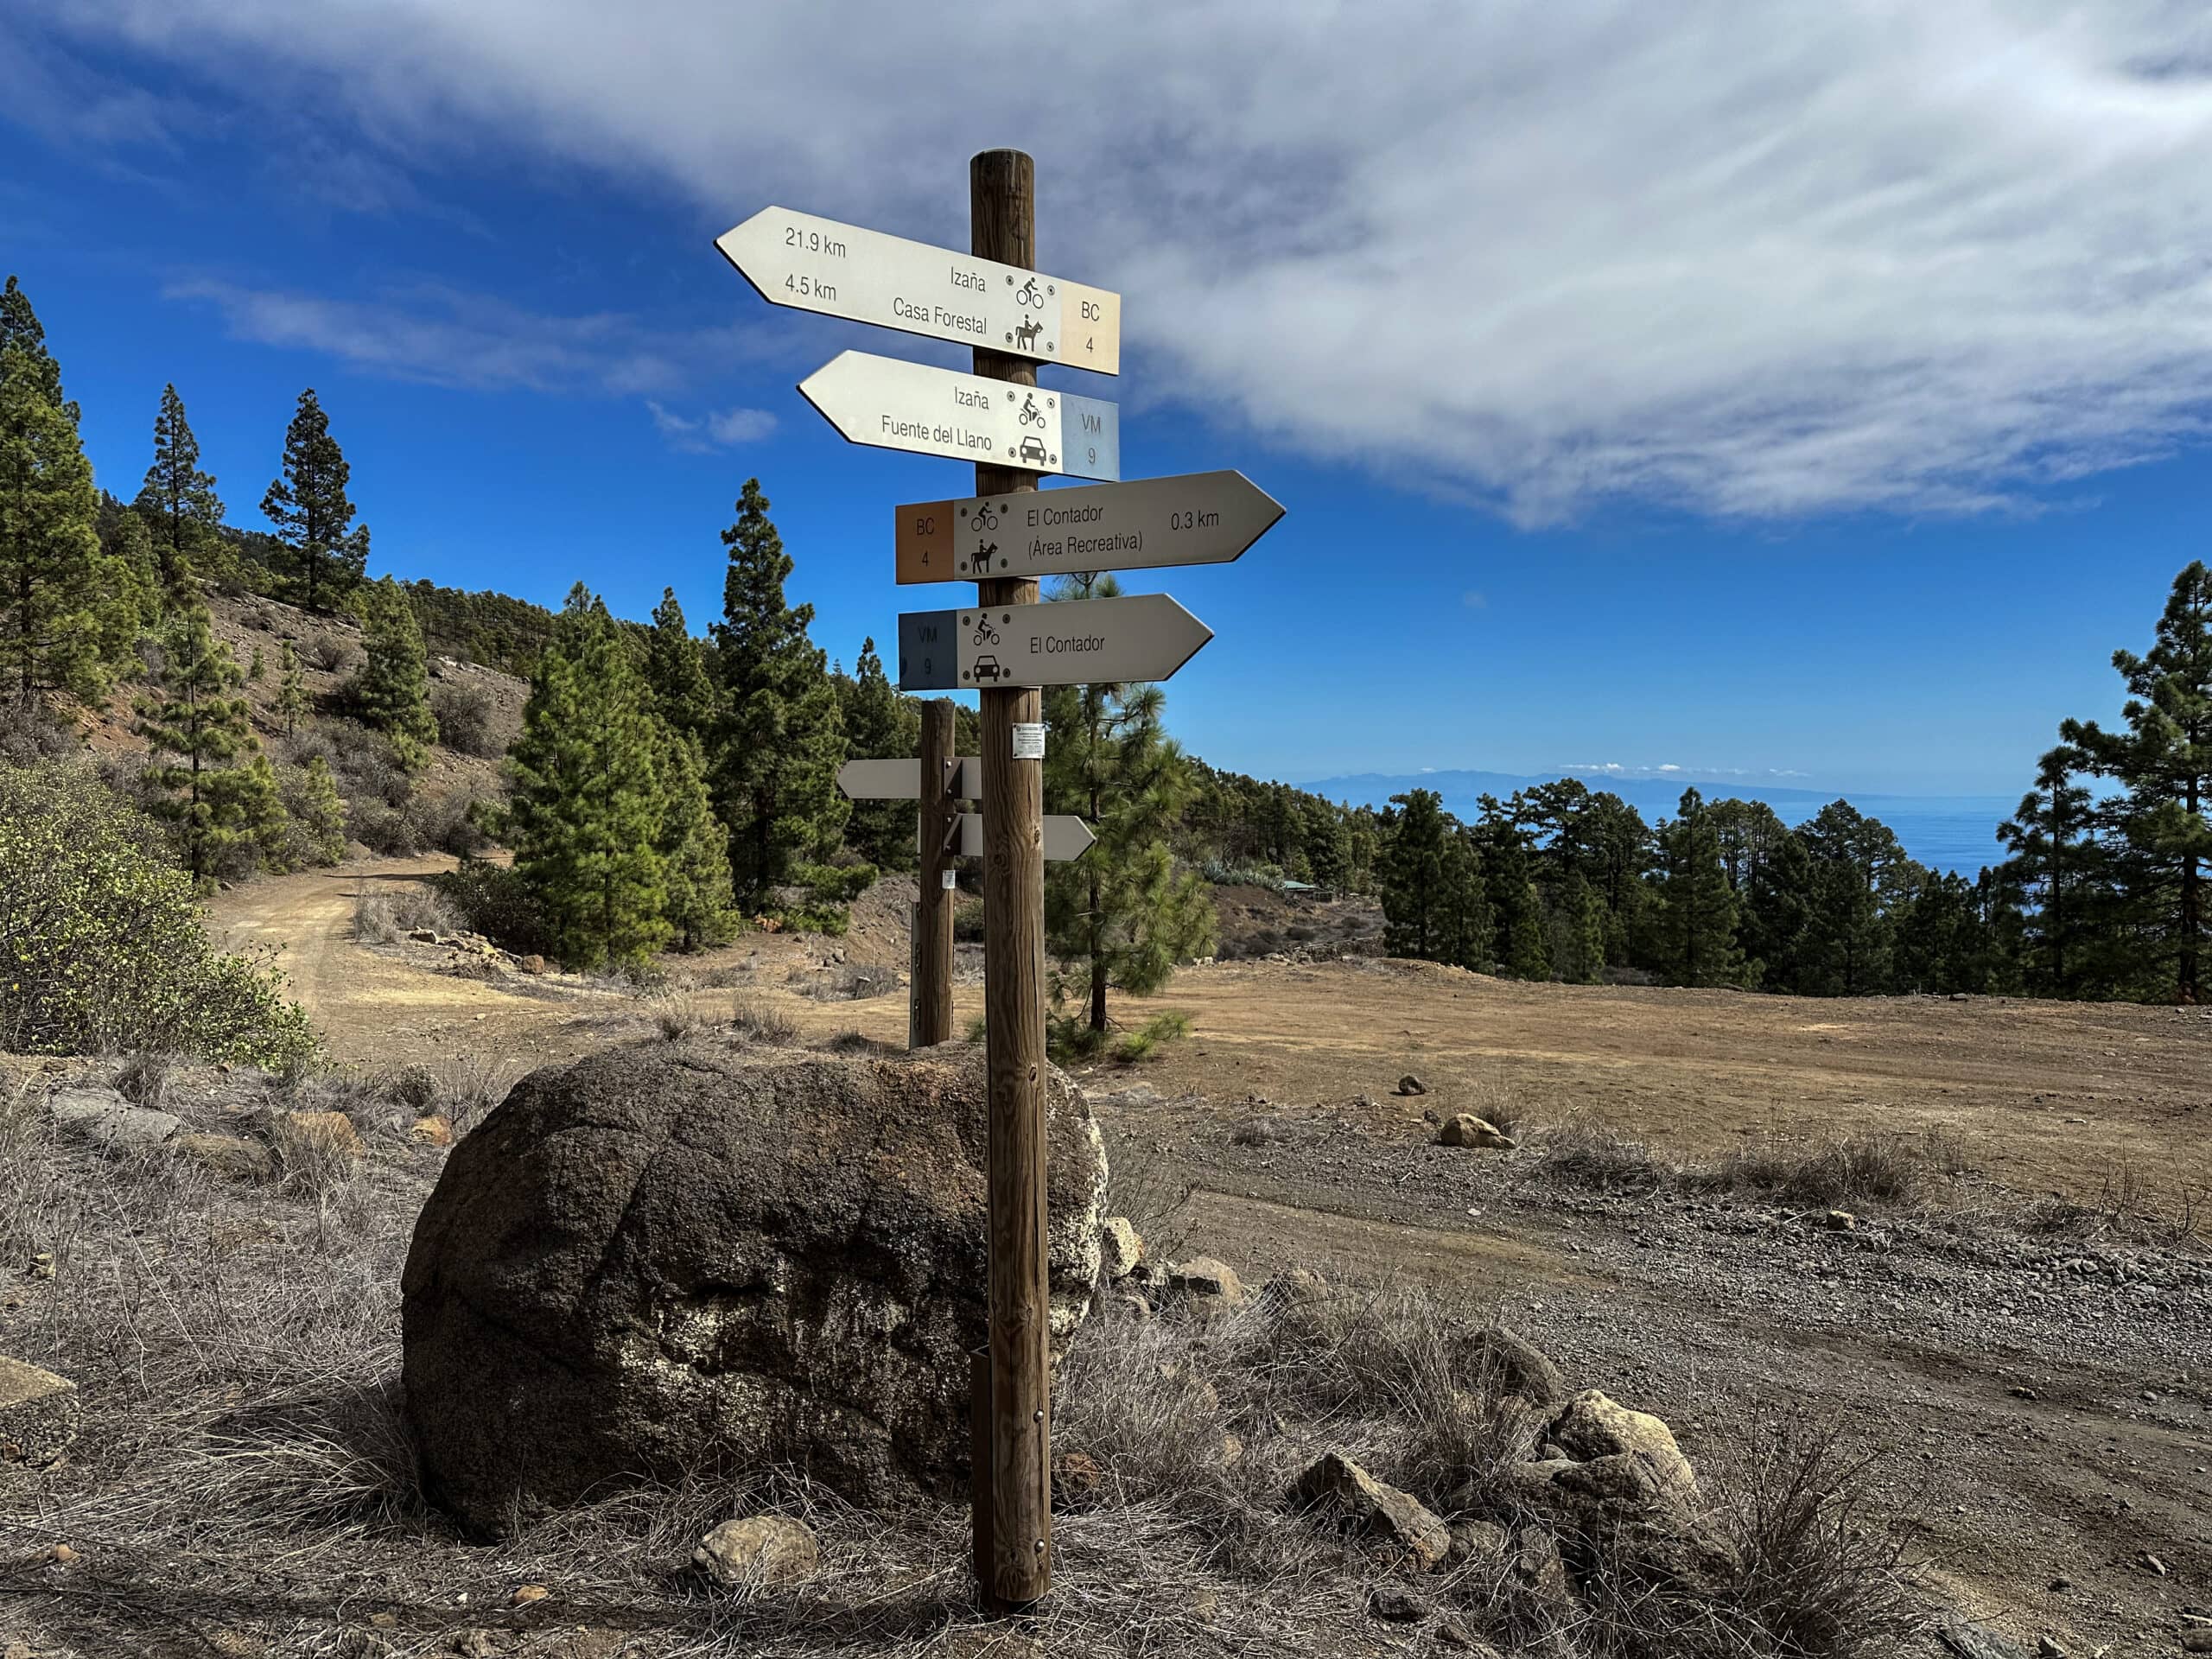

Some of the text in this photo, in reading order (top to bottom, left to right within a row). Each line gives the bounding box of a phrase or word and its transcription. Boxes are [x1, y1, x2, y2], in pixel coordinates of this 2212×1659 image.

[785, 226, 846, 258] 21.9 km
[785, 274, 836, 301] 4.5 km
[950, 266, 986, 293] Izaña
[893, 299, 988, 335] Casa Forestal
[1081, 301, 1100, 322] BC
[1085, 336, 1094, 353] 4
[954, 386, 989, 410] Izaña
[882, 415, 992, 451] Fuente del Llano
[1082, 413, 1102, 433] VM
[1088, 448, 1096, 464] 9
[1027, 505, 1103, 527] El Contador
[1171, 510, 1219, 531] 0.3 km
[916, 518, 935, 536] BC
[1027, 531, 1143, 561] (Área Recreativa)
[921, 551, 930, 568] 4
[918, 626, 938, 645] VM
[1030, 634, 1105, 654] El Contador
[924, 658, 932, 675] 9
